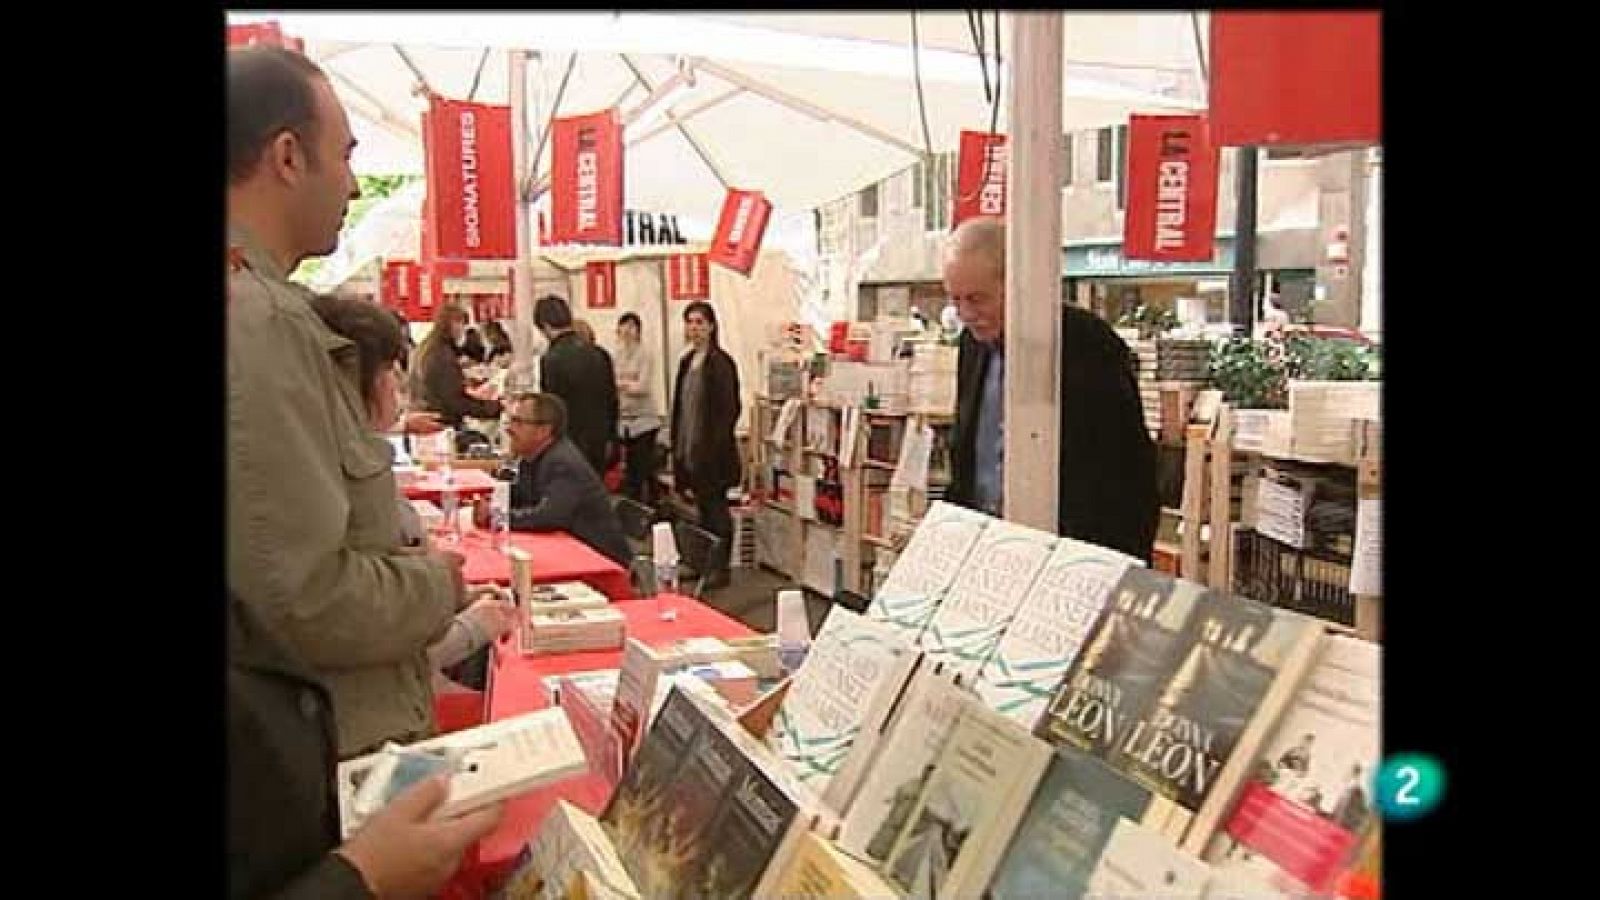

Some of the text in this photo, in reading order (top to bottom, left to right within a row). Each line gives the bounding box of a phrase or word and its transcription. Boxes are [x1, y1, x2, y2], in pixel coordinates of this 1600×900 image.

[460, 111, 480, 247] SIGNATURES
[1154, 160, 1189, 252] CENTRAL
[1048, 684, 1126, 744] LEON
[1122, 720, 1221, 792] LEON
